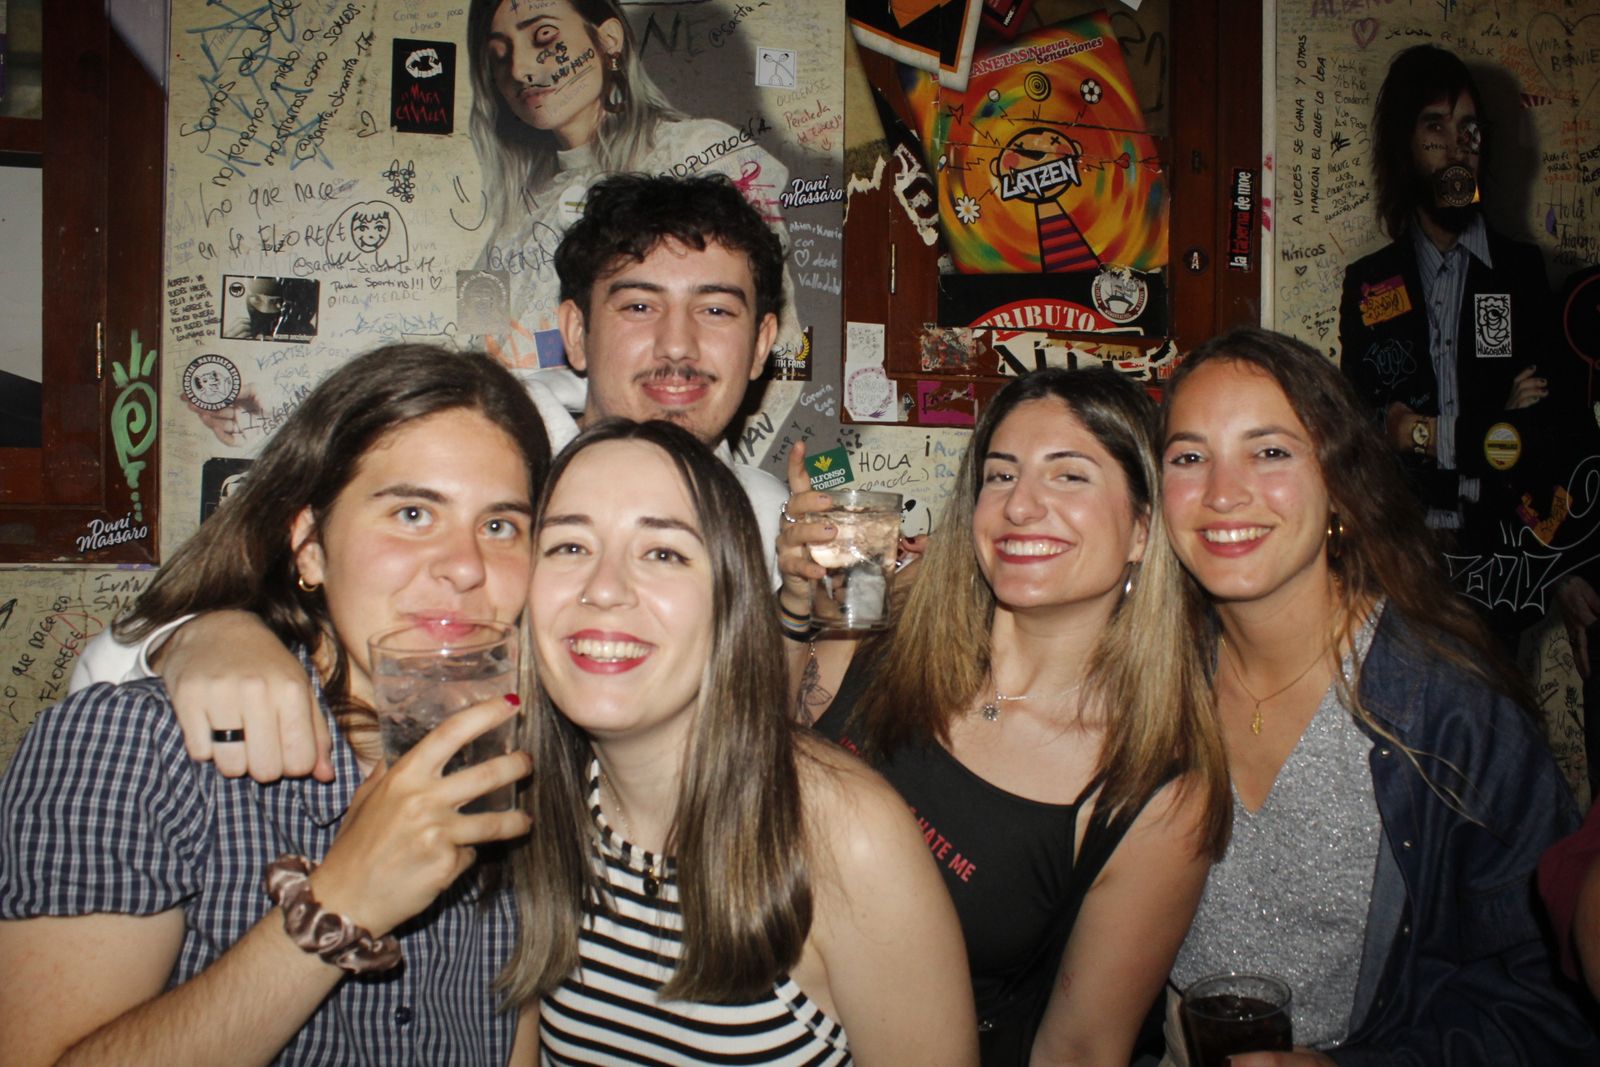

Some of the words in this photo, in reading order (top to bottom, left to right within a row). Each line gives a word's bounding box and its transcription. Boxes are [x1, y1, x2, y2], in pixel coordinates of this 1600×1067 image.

[1036, 37, 1104, 65] Sensaciones
[1294, 98, 1305, 133] GANA
[1293, 138, 1304, 156] SE
[792, 174, 830, 194] Dani
[1003, 158, 1079, 199] LATZEN
[1238, 171, 1252, 195] moe
[781, 189, 843, 208] Massaro
[1234, 196, 1252, 211] de
[1230, 256, 1248, 267] la
[859, 451, 912, 473] HOLA
[810, 468, 846, 485] ALFONSO
[87, 512, 131, 536] Dani
[76, 525, 148, 552] Massaro
[948, 853, 977, 883] ME
